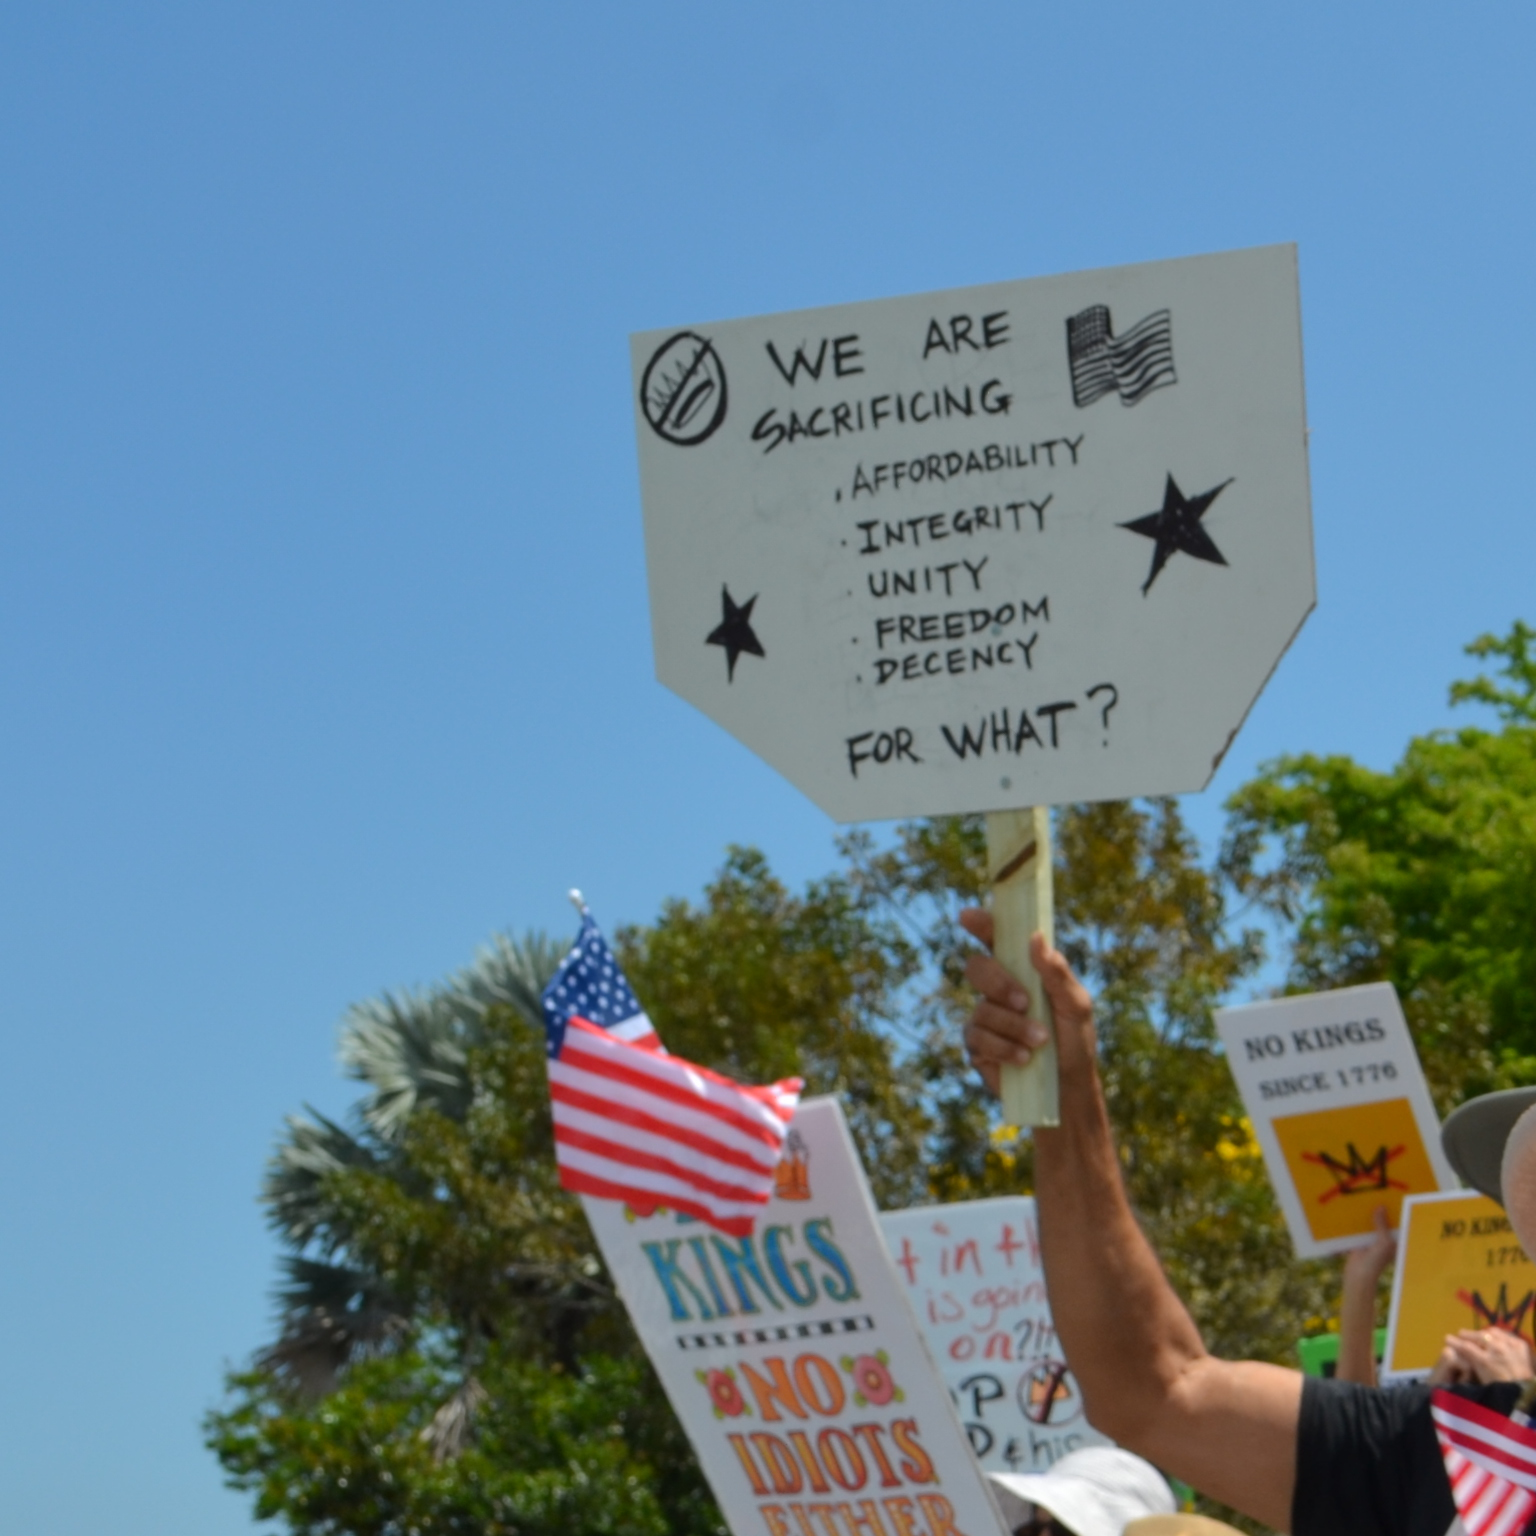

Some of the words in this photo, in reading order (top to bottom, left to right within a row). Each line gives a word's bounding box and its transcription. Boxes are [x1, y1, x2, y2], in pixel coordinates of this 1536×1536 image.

[767, 334, 866, 388] WE
[922, 311, 1013, 360] ARE
[751, 379, 1014, 454] SACRIFICING
[851, 434, 1086, 499] AFFORDABILITY
[858, 494, 1054, 556] INTEGRITY
[867, 557, 989, 599] UNITY
[875, 596, 1051, 649] FREEDOM
[874, 632, 1039, 685] DECENCY
[845, 726, 923, 779] FOR
[1244, 1032, 1286, 1062] NO
[1293, 1017, 1386, 1054] KINGS
[1258, 1072, 1331, 1102] SINCE
[1336, 1060, 1399, 1089] 1776
[930, 1220, 984, 1277] in
[1440, 1219, 1467, 1239] NO
[640, 1216, 862, 1321] KINGS
[925, 1288, 965, 1325] is
[970, 1279, 1048, 1333] goin
[739, 1353, 846, 1424] NO
[727, 1418, 942, 1497] IDIOTS
